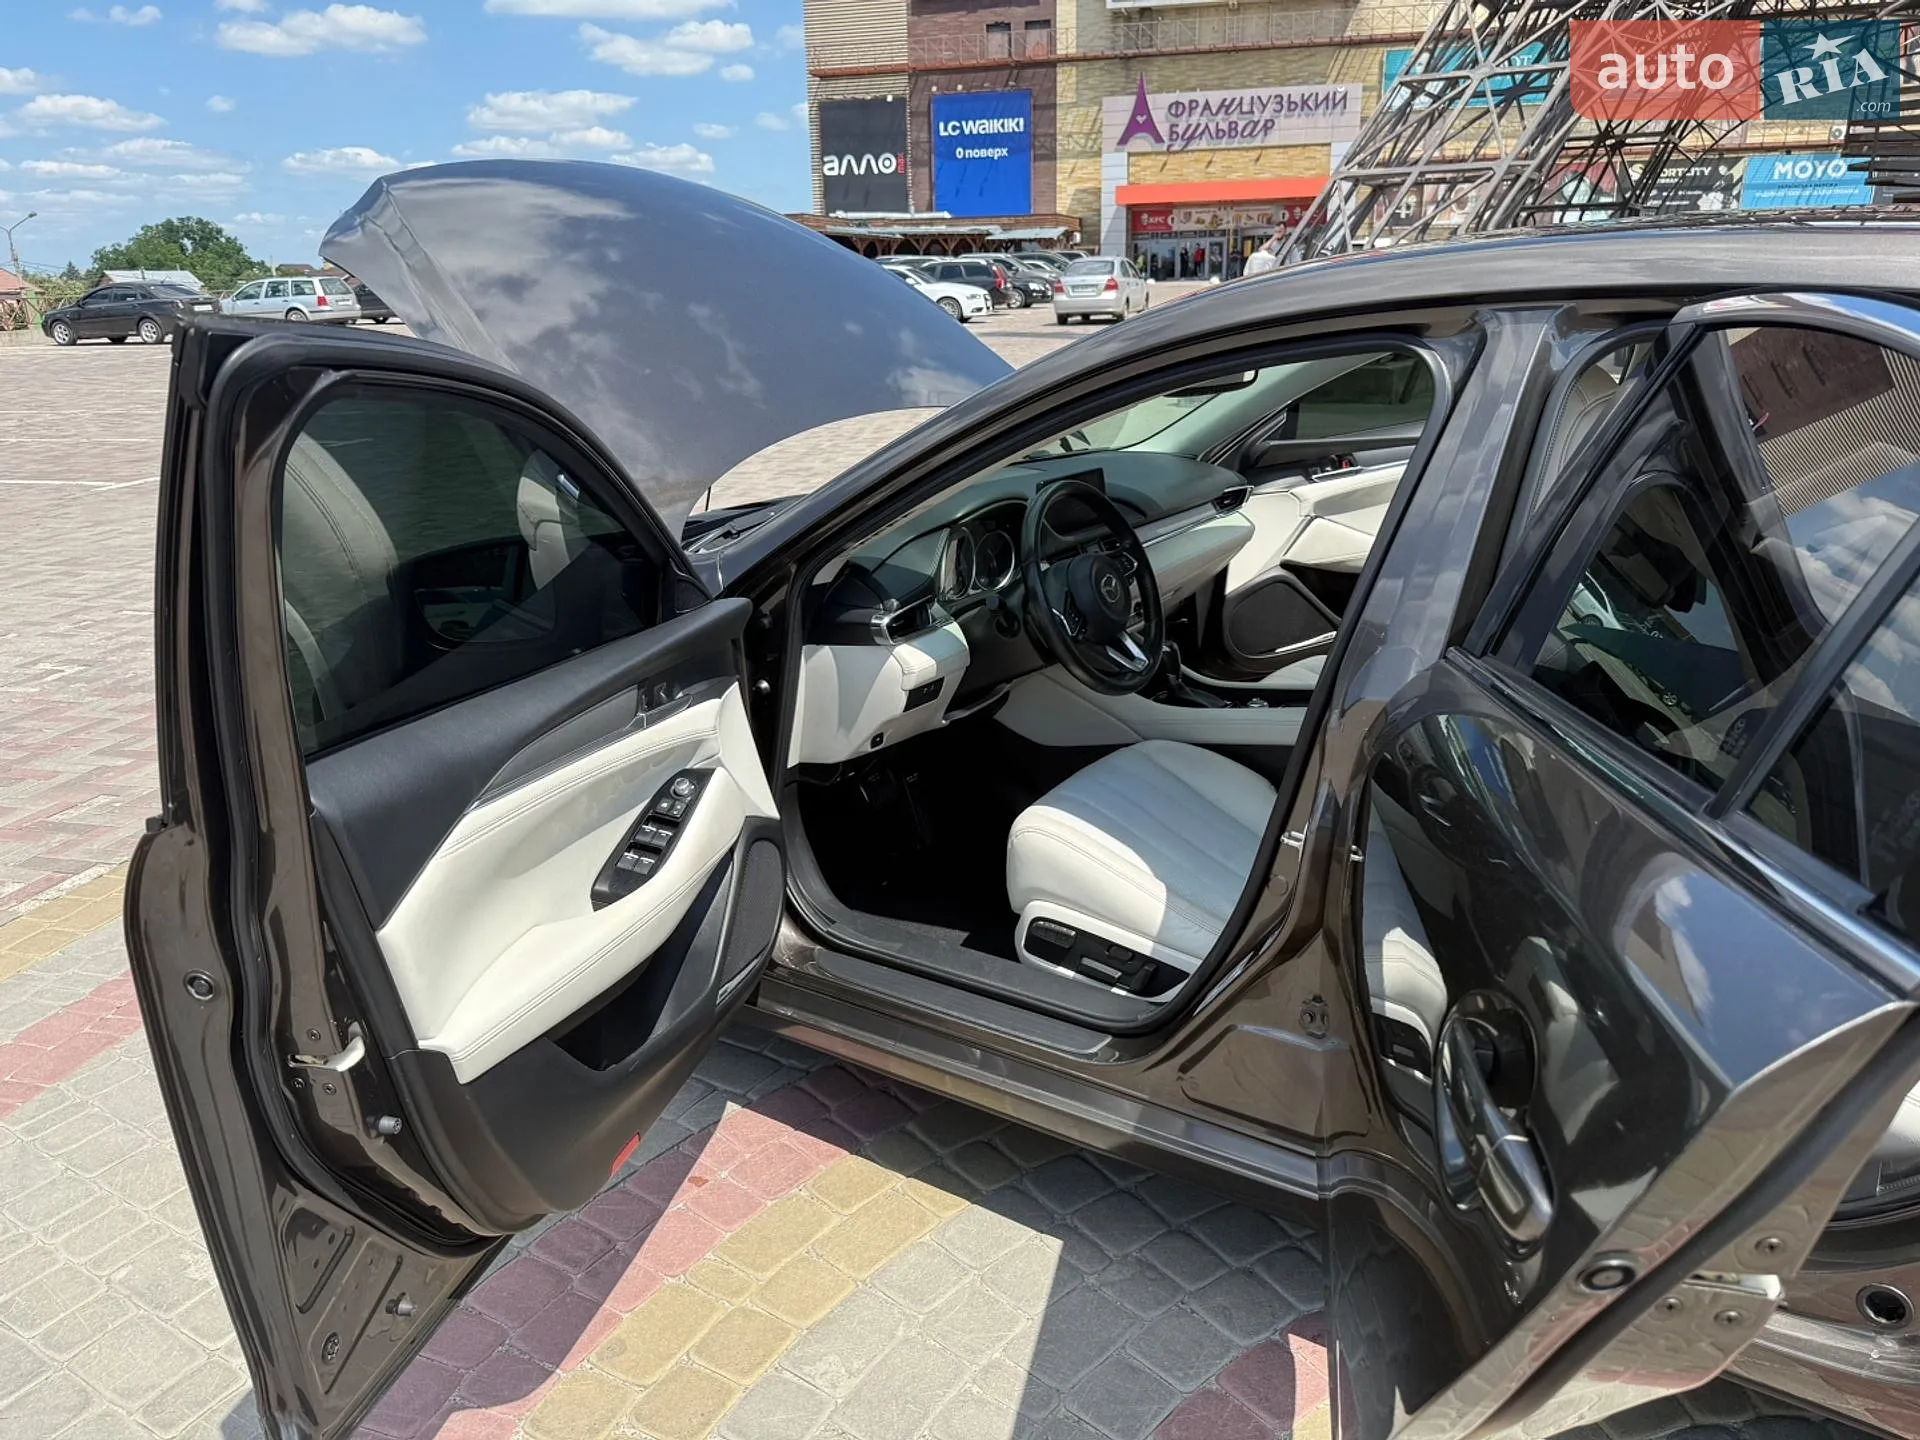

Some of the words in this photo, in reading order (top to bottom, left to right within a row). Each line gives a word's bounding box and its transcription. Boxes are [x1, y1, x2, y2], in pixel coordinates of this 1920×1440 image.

[1167, 86, 1348, 119] ФРАНЦУЗЬКИЙ
[938, 121, 961, 137] LC
[965, 147, 1009, 160] поверх
[1773, 158, 1848, 180] MOYO
